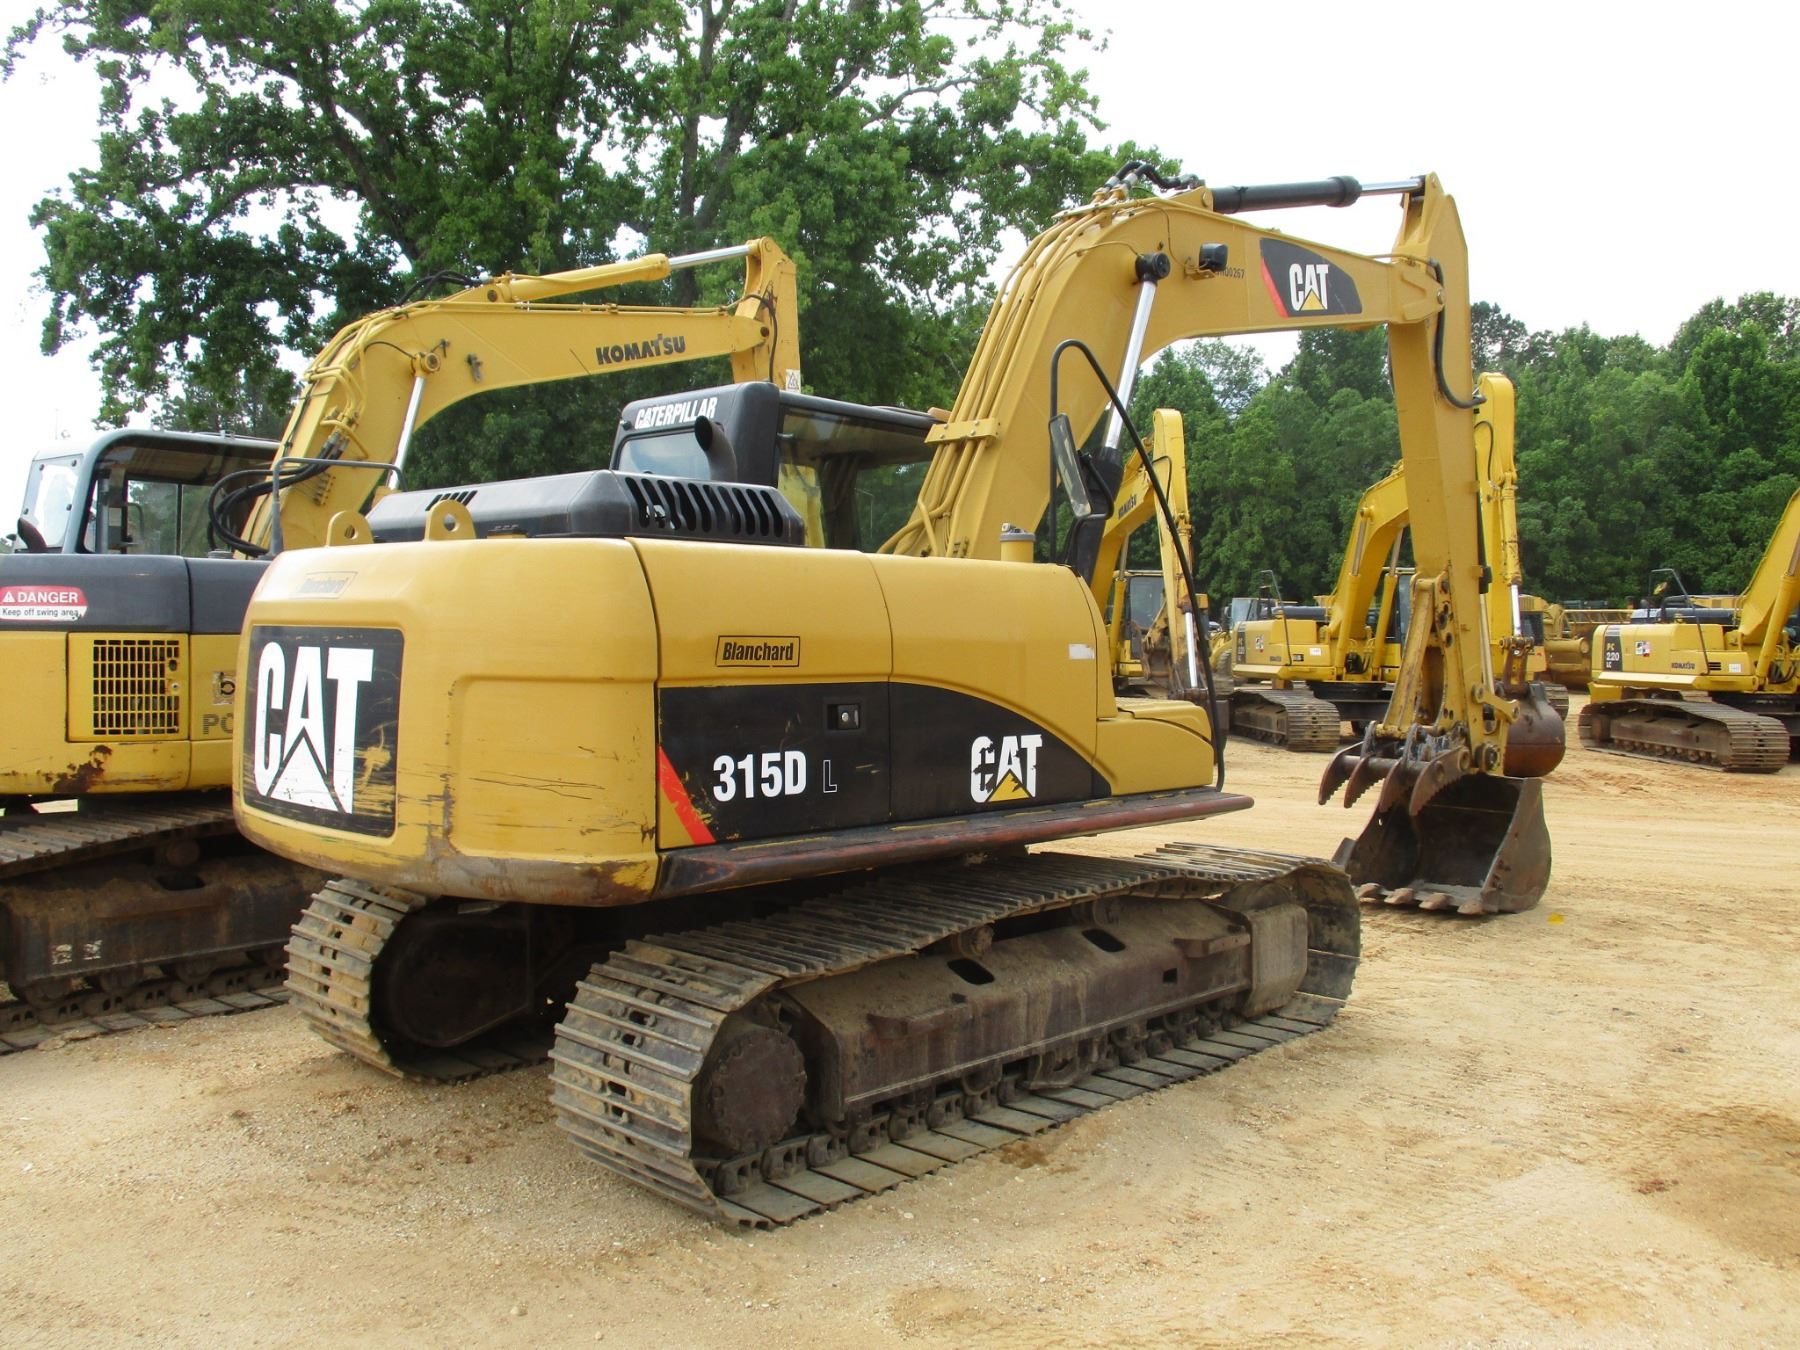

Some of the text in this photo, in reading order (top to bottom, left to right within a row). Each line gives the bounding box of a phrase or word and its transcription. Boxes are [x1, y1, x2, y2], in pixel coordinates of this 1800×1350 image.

[1289, 263, 1328, 312] CAT
[596, 334, 686, 365] KOMATSU
[634, 397, 718, 430] CATERPILLAR
[2, 608, 22, 617] Keep
[24, 608, 35, 616] off
[37, 608, 58, 617] swing
[17, 591, 79, 603] DANGER
[722, 642, 794, 661] Blanchard
[1606, 652, 1620, 661] 220
[253, 641, 375, 814] CAT
[712, 749, 838, 802] 315D L
[970, 733, 1042, 804] CAT
